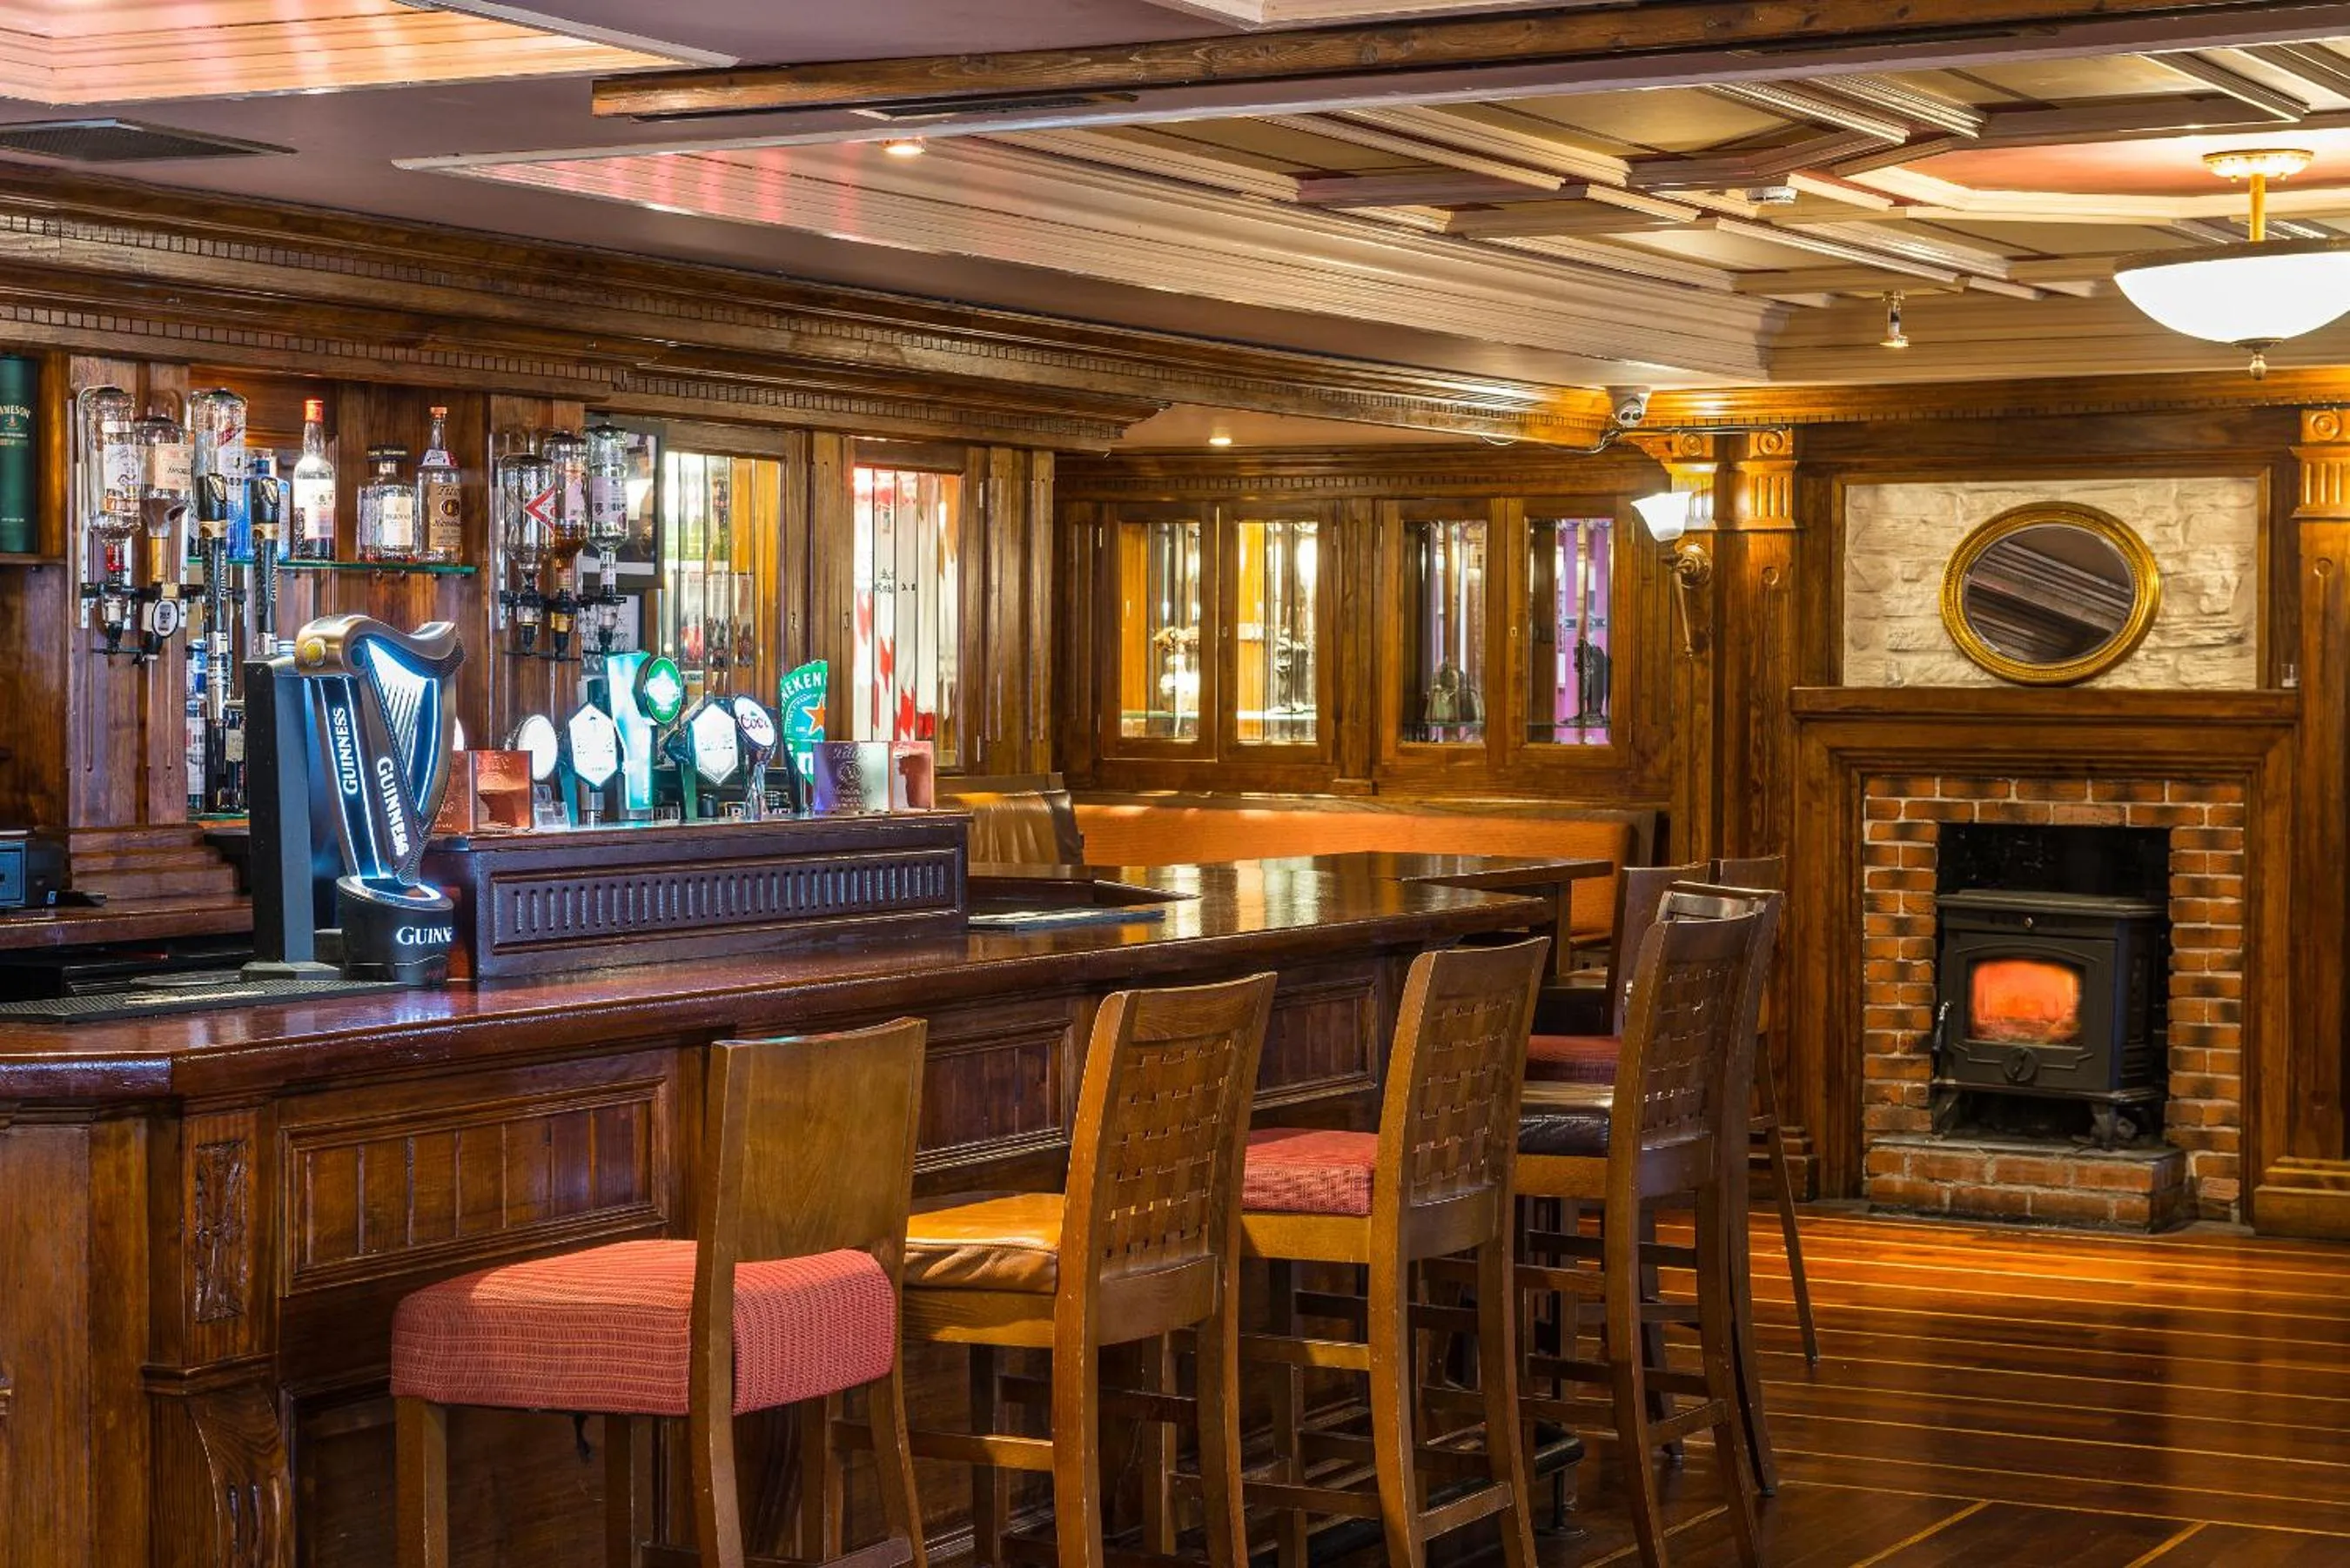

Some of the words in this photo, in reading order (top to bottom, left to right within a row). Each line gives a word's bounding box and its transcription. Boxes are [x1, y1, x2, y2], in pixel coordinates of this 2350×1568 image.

[781, 672, 822, 704] NEKEN
[333, 707, 359, 795] GUINNESS
[377, 756, 410, 856] GUINNESS
[395, 926, 453, 946] GUINN
